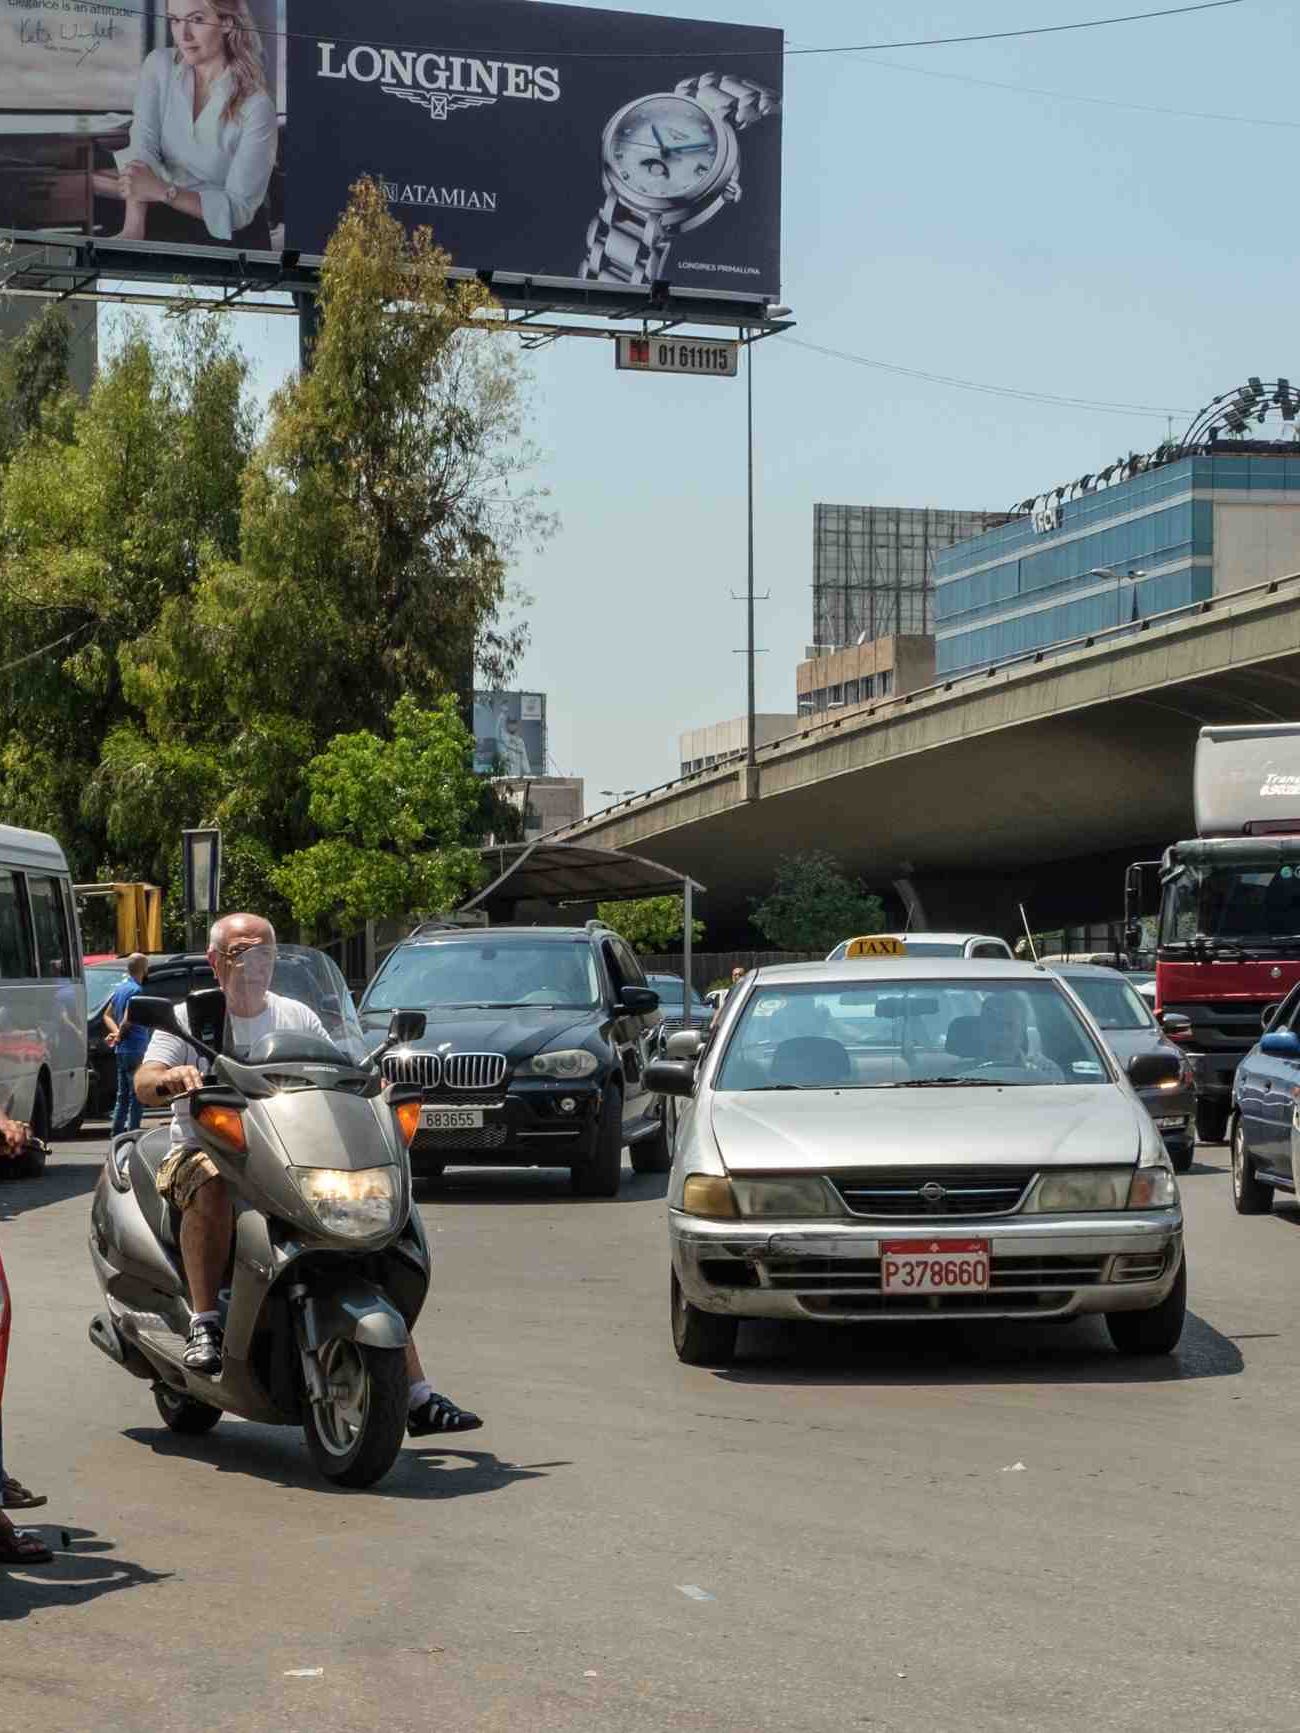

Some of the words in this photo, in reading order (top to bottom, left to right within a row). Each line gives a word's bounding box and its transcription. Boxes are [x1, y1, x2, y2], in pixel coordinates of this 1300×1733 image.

[316, 42, 561, 102] LONGINES
[400, 184, 498, 209] ATAMIAN
[659, 343, 676, 366] 01
[856, 941, 899, 954] TAXI
[426, 1113, 475, 1127] 683655
